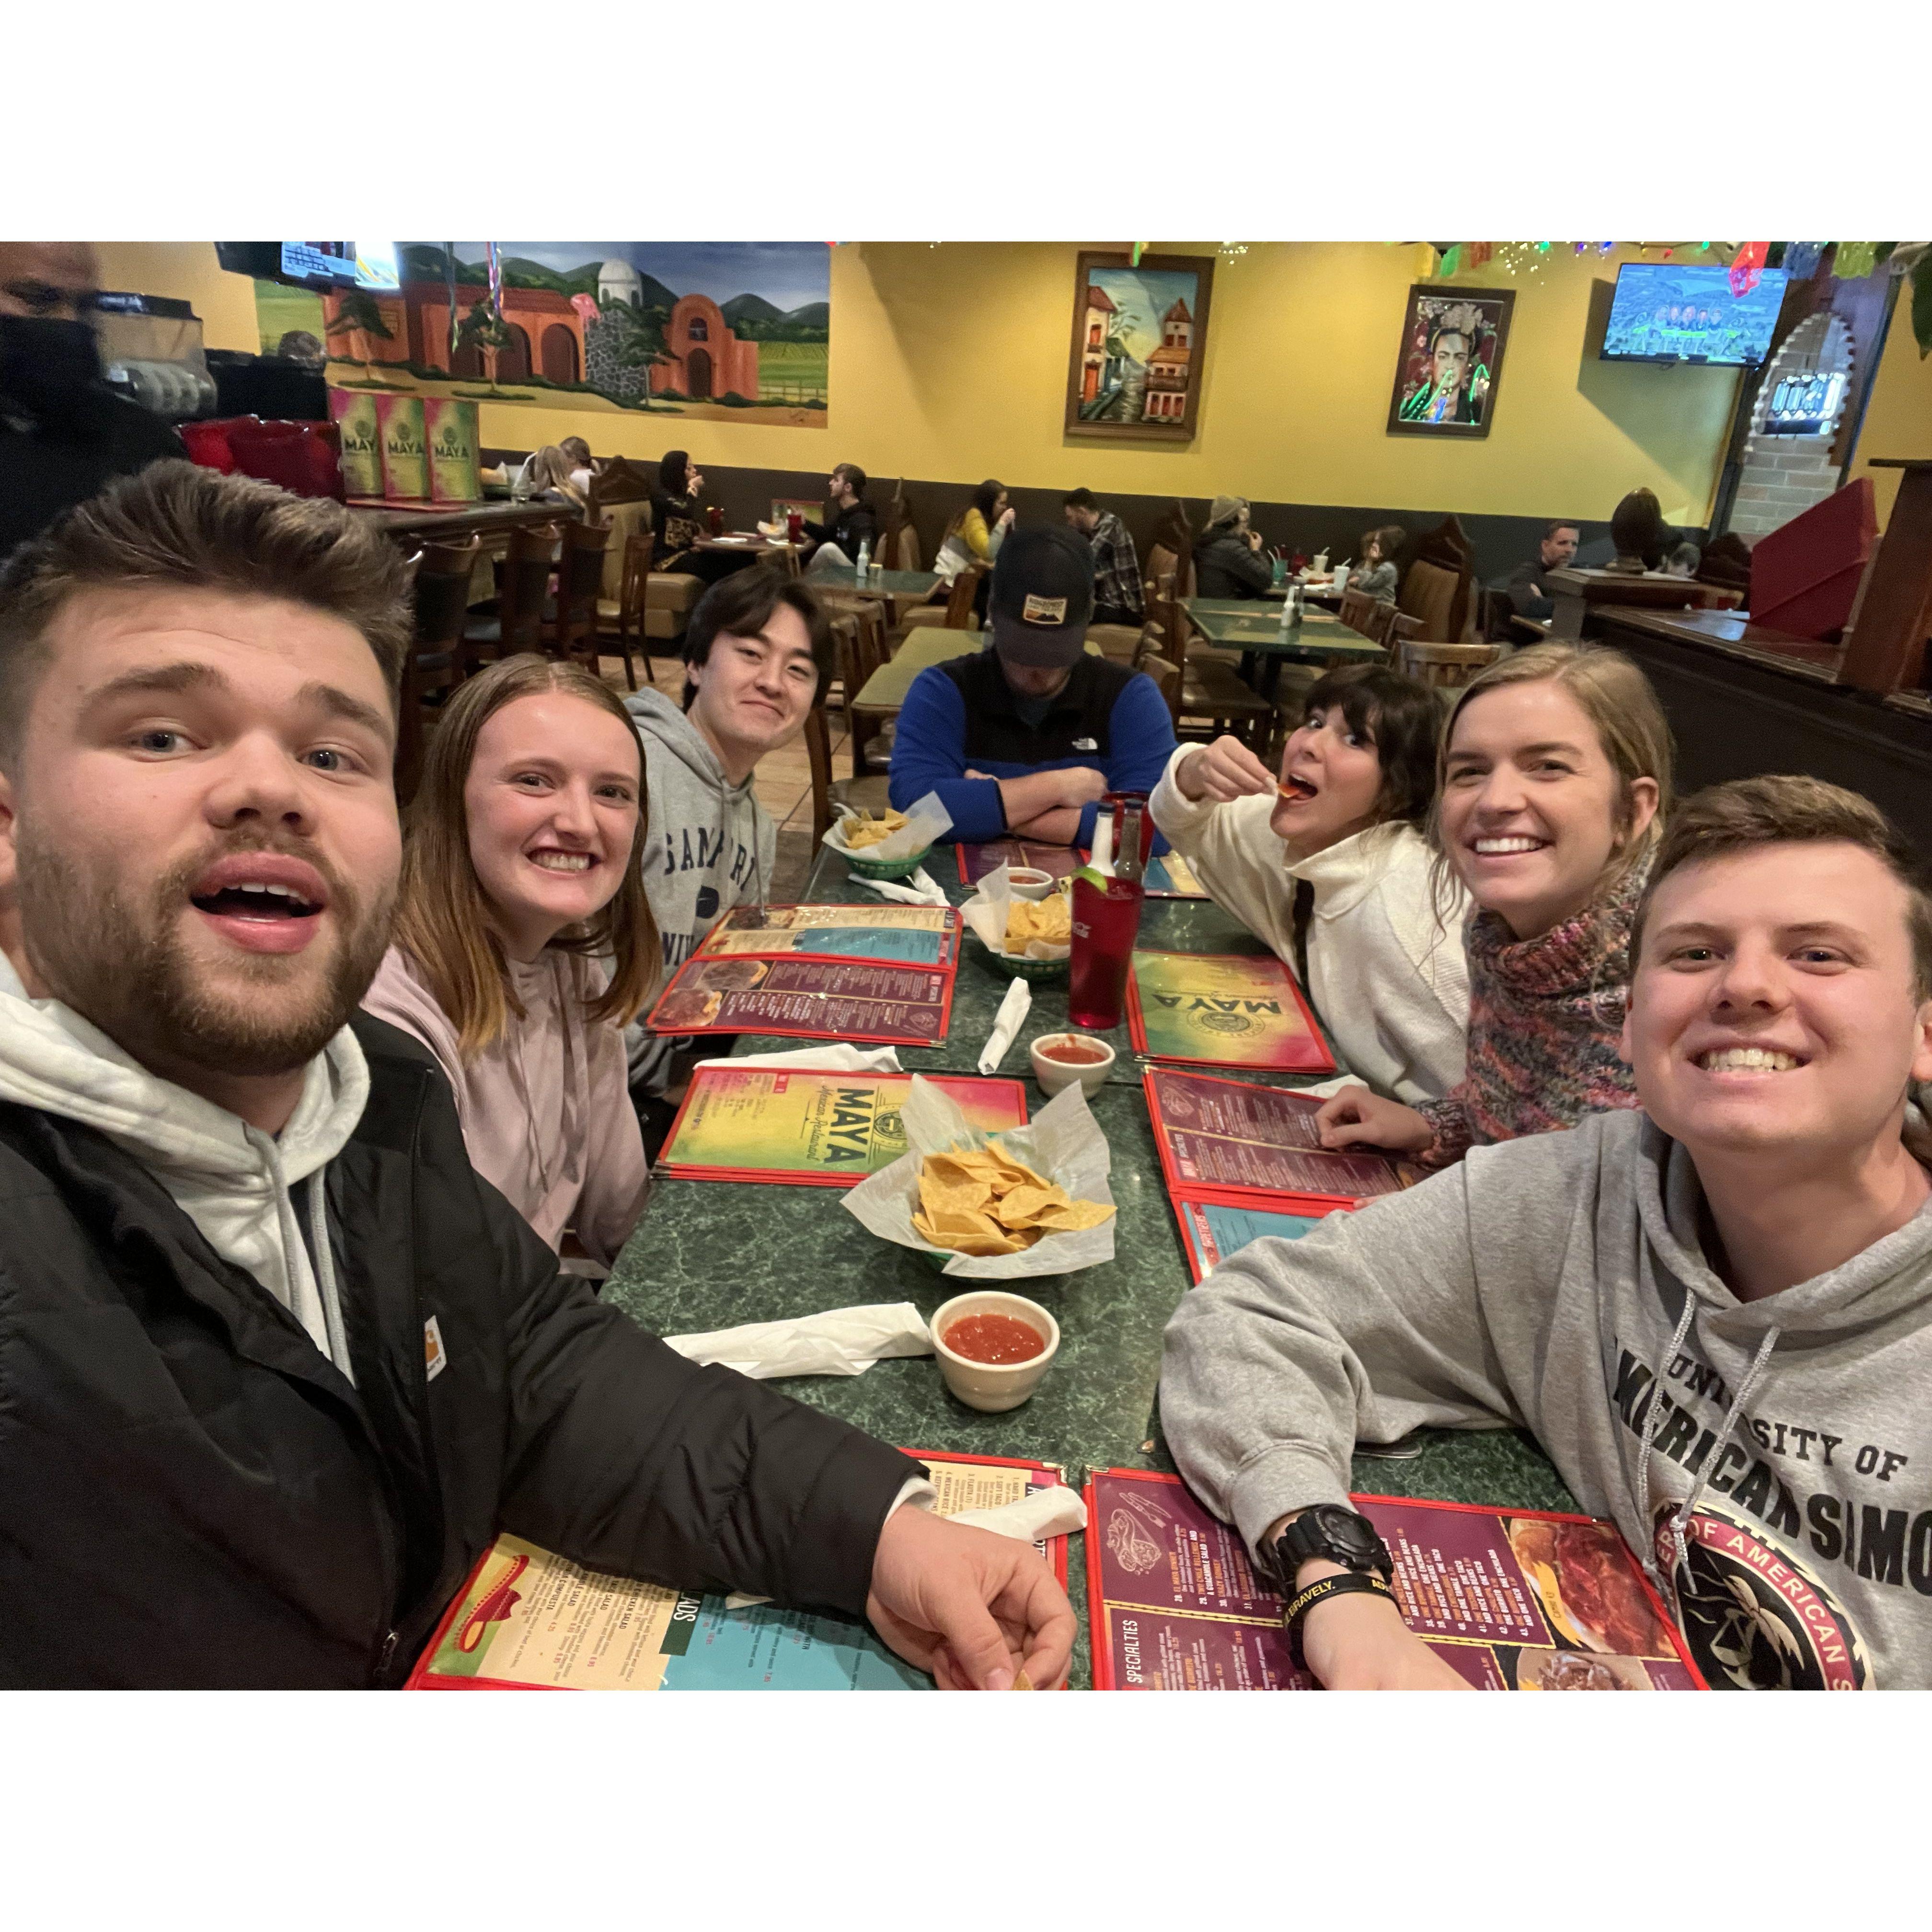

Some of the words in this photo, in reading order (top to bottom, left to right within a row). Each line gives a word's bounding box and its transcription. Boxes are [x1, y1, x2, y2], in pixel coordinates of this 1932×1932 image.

[435, 446, 470, 457] MAYA
[1152, 994, 1282, 1014] MAYA
[824, 1088, 875, 1163] MAYA
[1854, 1445, 1909, 1482] OF
[943, 1477, 952, 1497] MEXICAN
[1199, 1543, 1209, 1559] SALAD
[1399, 1538, 1410, 1555] BEANS
[1404, 1555, 1414, 1566] AND
[1411, 1544, 1426, 1572] ENCHILADA
[1431, 1549, 1442, 1561] TACO
[1437, 1562, 1446, 1573] ONE
[1454, 1560, 1465, 1573] TACO
[1473, 1561, 1484, 1574] TACO
[1487, 1549, 1505, 1576] ENCHILADA
[1202, 1560, 1213, 1590] GUACAMOLE
[1396, 1561, 1407, 1579] BEANS
[1408, 1567, 1418, 1580] RICE
[1426, 1564, 1438, 1581] BEANS
[1466, 1568, 1478, 1585] BEANS
[1402, 1579, 1411, 1590] AND
[1420, 1573, 1430, 1584] ONE
[1460, 1574, 1470, 1585] ONE
[1479, 1574, 1489, 1586] ONE
[1499, 1577, 1509, 1587] ONE
[1433, 1582, 1442, 1593] AND
[1450, 1577, 1463, 1597] TAMALE
[1473, 1586, 1483, 1597] AND
[545, 1579, 567, 1611] COMPUESTA
[567, 1590, 580, 1607] SALAD
[1405, 1590, 1415, 1604] RICE
[1437, 1594, 1448, 1607] RICE
[1494, 1588, 1509, 1613] BURRITO
[1512, 1587, 1523, 1601] TACO
[1726, 1535, 1846, 1665] AMERICAN
[599, 1594, 612, 1610] SALAD
[1458, 1598, 1468, 1609] ONE
[1477, 1598, 1488, 1611] RICE
[1518, 1603, 1529, 1614] ONE
[1410, 1605, 1420, 1617] AND
[1441, 1608, 1451, 1620] AND
[1462, 1610, 1472, 1622] AND
[1483, 1612, 1493, 1623] AND
[619, 1612, 632, 1630] SALAD
[1503, 1613, 1514, 1625] ONE
[1523, 1614, 1534, 1626] AND
[1122, 1620, 1143, 1683] SPECIALTIES
